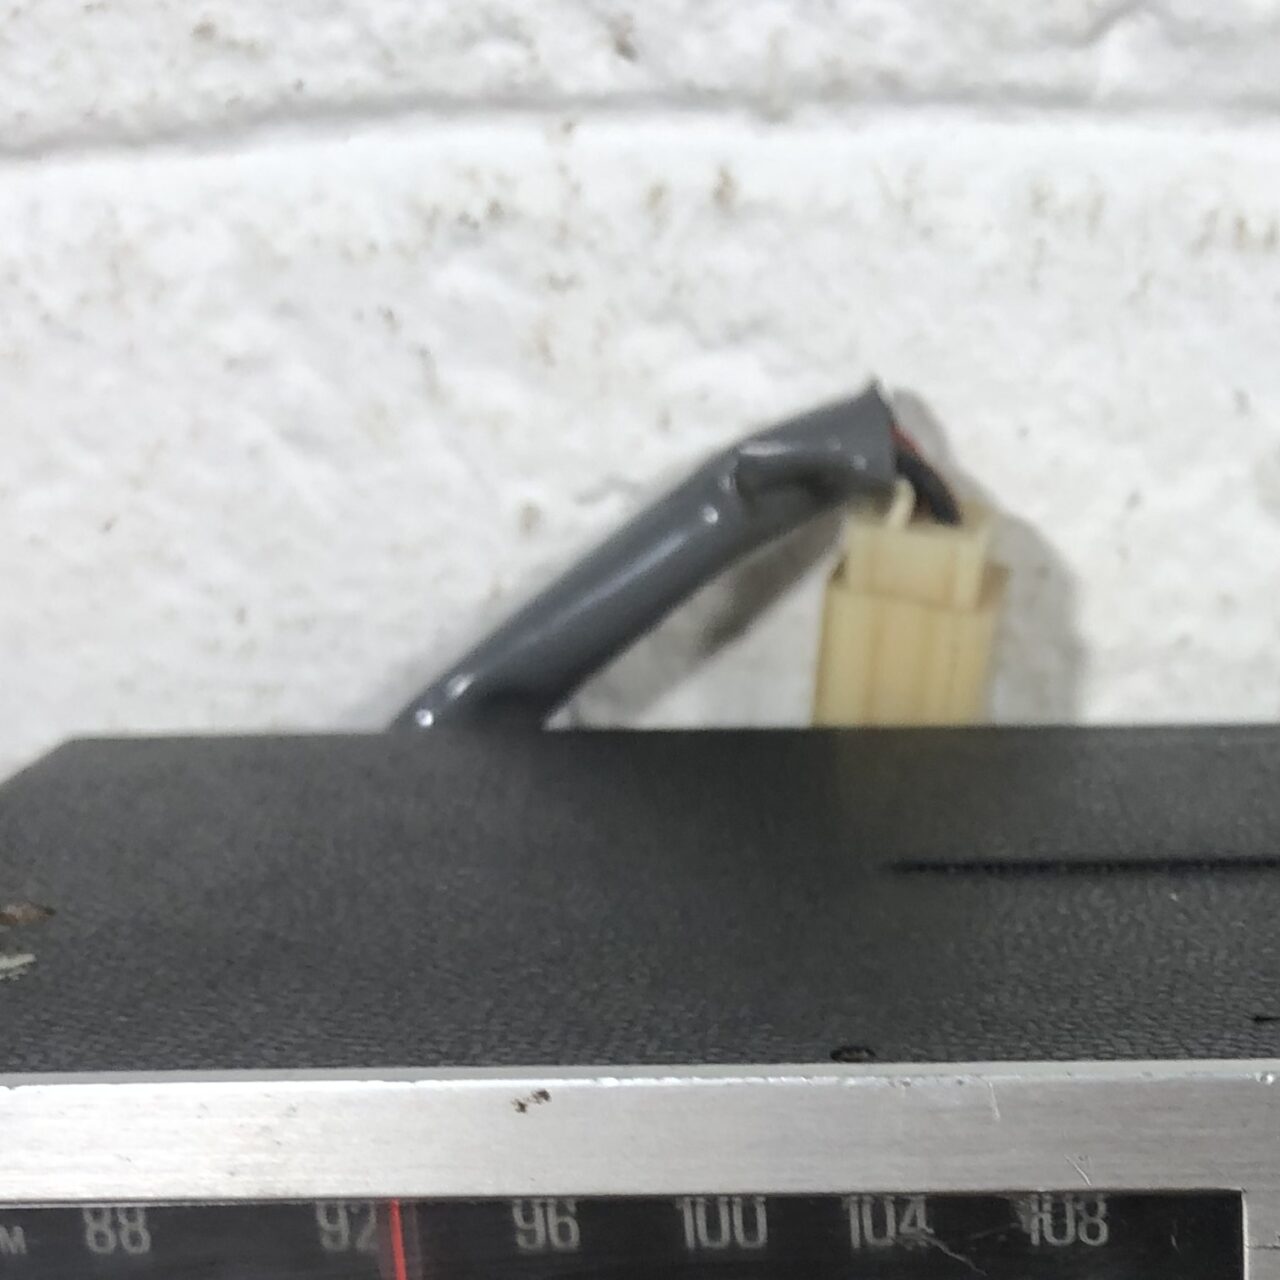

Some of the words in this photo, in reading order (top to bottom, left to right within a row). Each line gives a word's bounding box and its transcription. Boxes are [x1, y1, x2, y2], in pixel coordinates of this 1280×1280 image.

[82, 1207, 151, 1254] 88
[315, 1201, 378, 1254] 92
[512, 1199, 580, 1251] 96
[677, 1197, 768, 1250] 100
[843, 1196, 934, 1248] 104
[1028, 1192, 1109, 1247] 108
